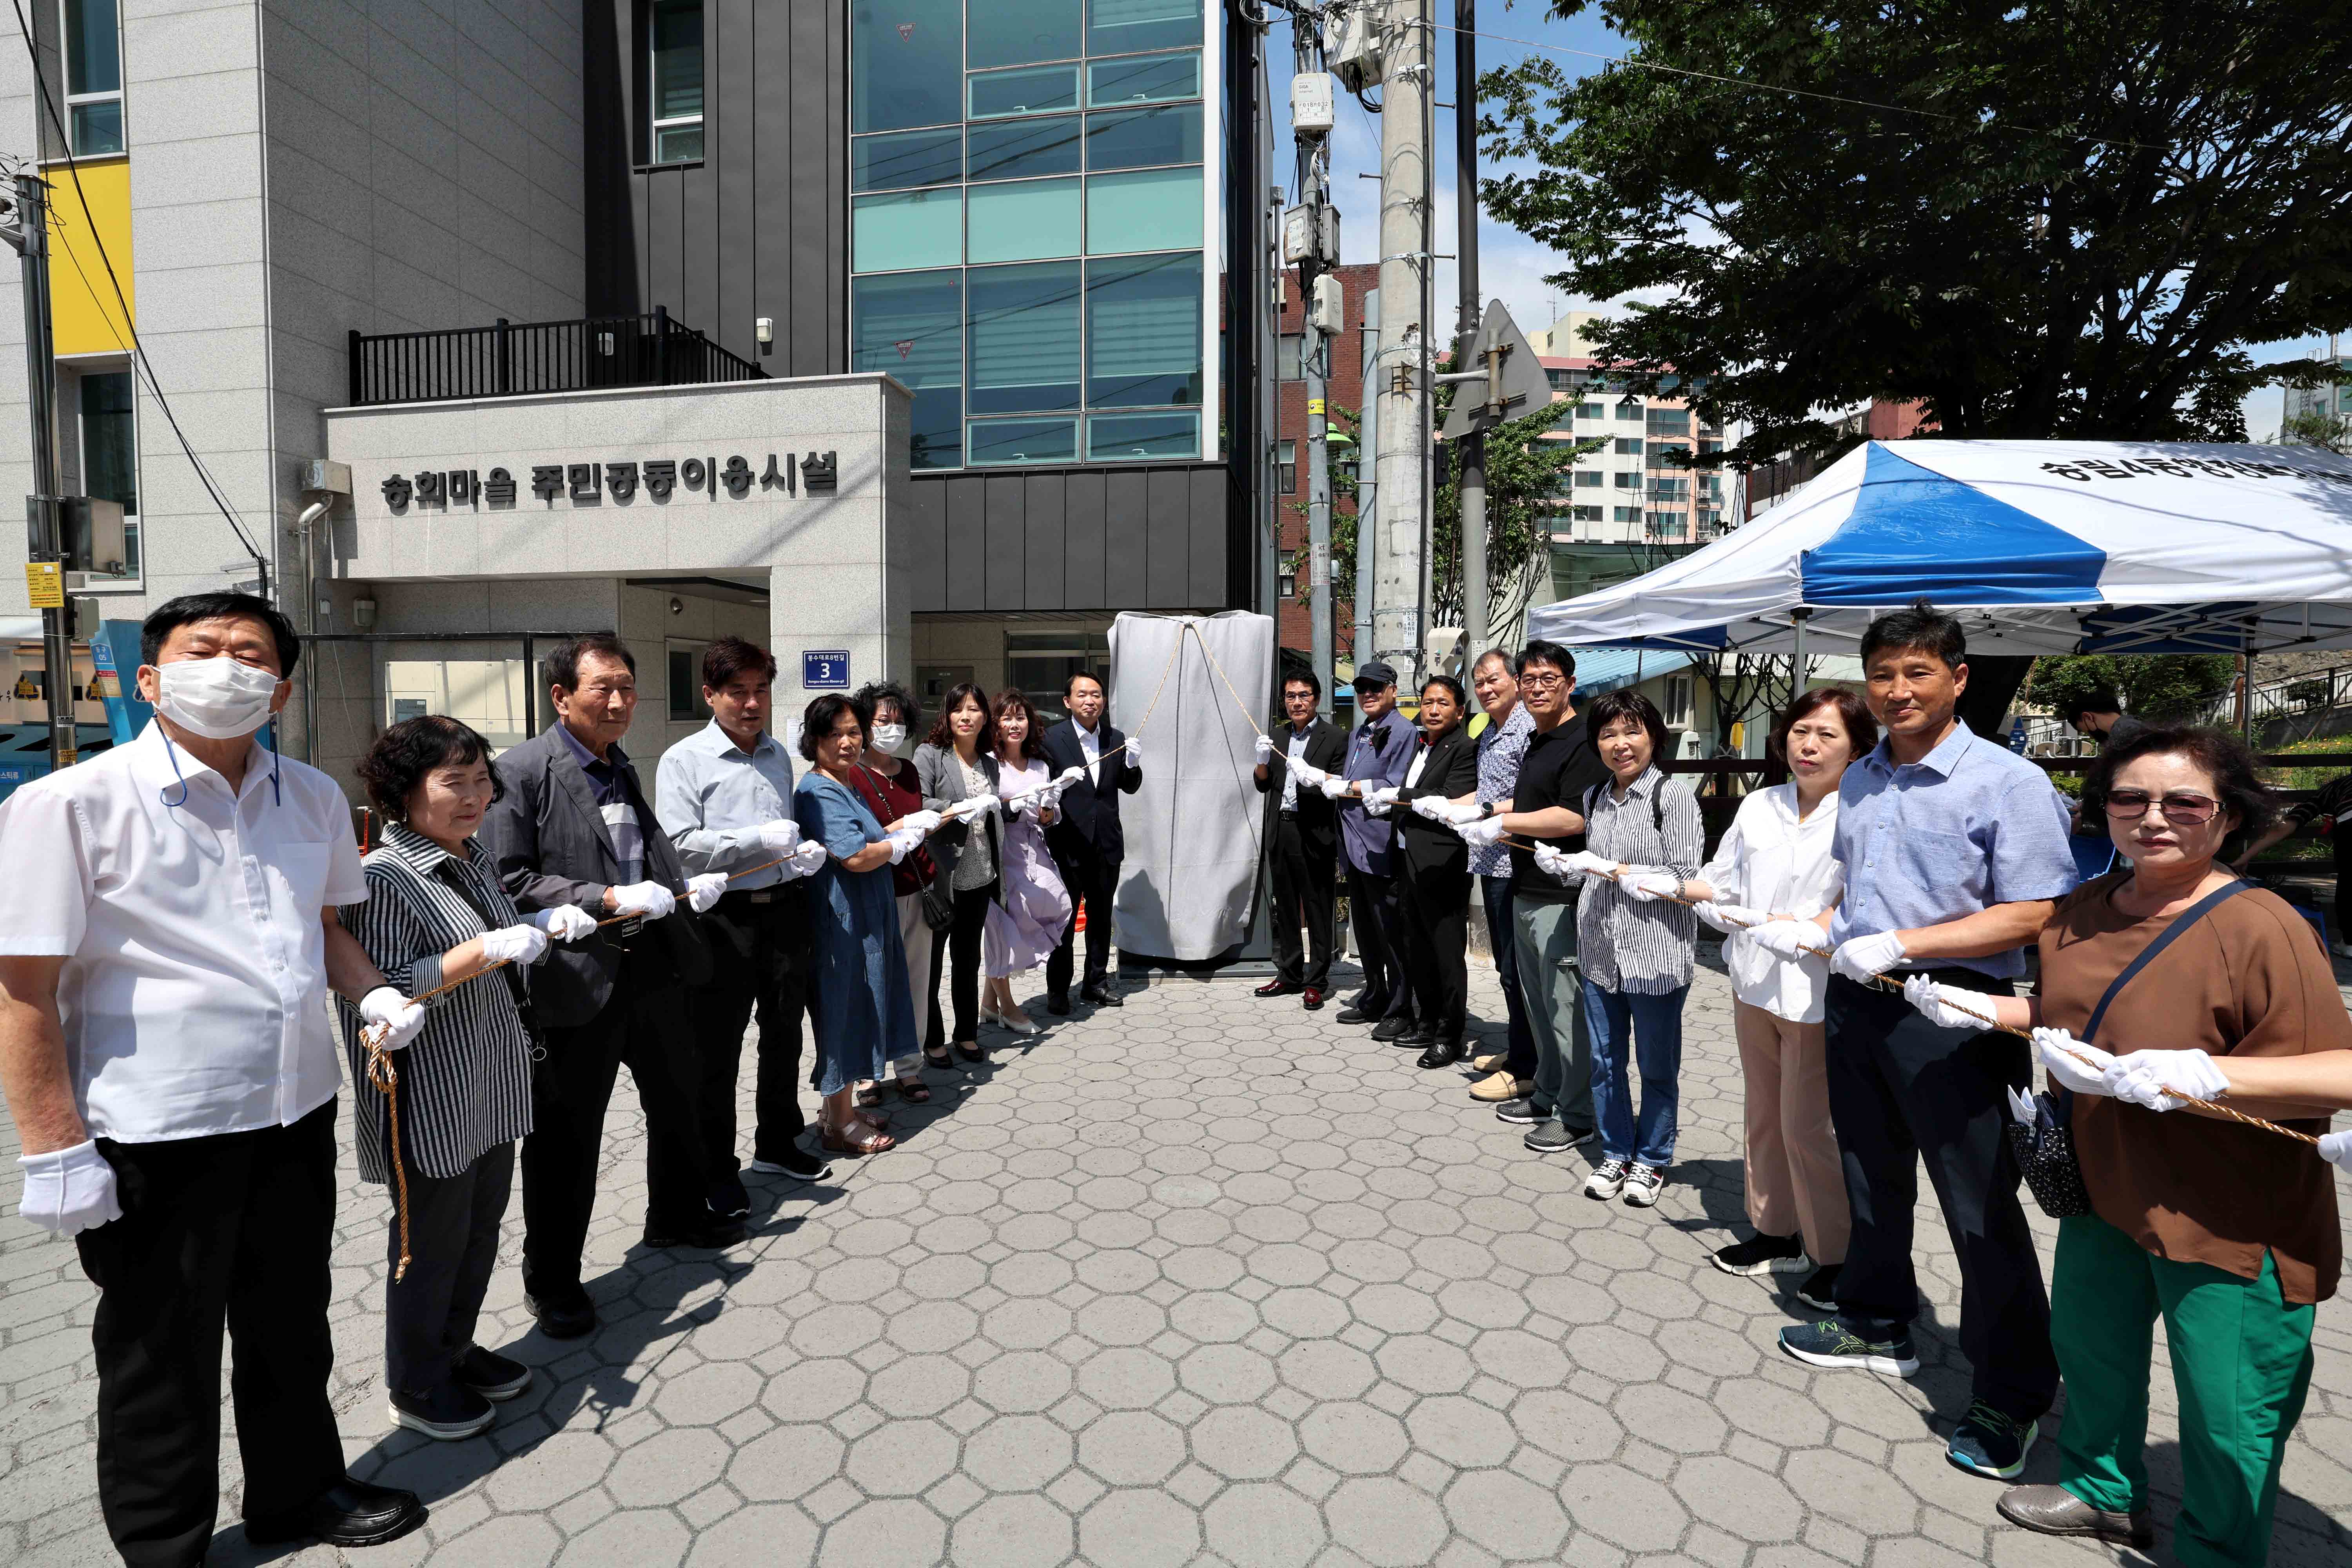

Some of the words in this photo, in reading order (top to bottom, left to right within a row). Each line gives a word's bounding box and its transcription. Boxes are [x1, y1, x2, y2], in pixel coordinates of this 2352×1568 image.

[381, 466, 517, 509] 송희마을
[532, 451, 838, 503] 주민공동이용시설
[820, 662, 830, 678] 3
[0, 771, 19, 780] 스틱류
